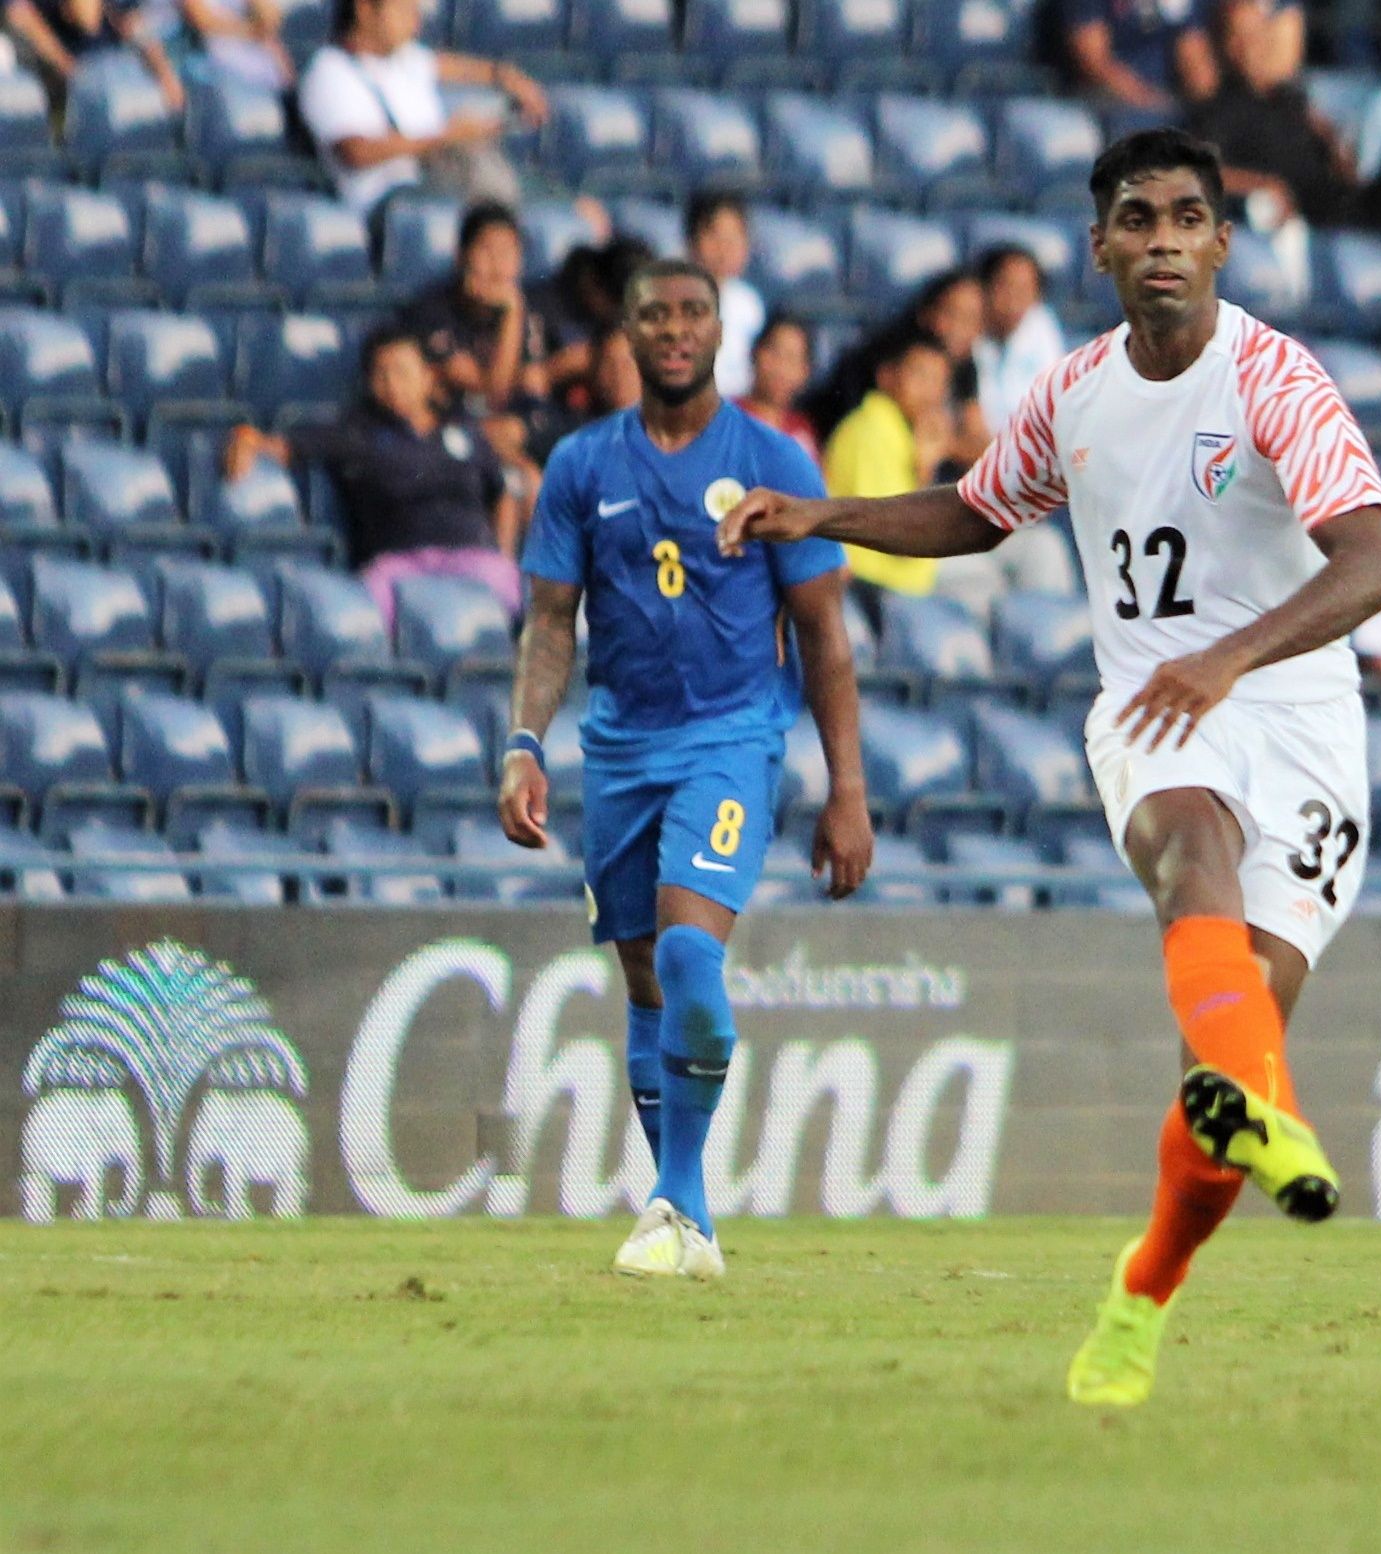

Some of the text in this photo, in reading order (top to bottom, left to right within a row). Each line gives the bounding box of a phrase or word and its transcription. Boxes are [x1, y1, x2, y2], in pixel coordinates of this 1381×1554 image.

[653, 540, 686, 598] 8
[1111, 526, 1195, 620] 32
[710, 799, 745, 857] 8
[1288, 799, 1359, 907] 32
